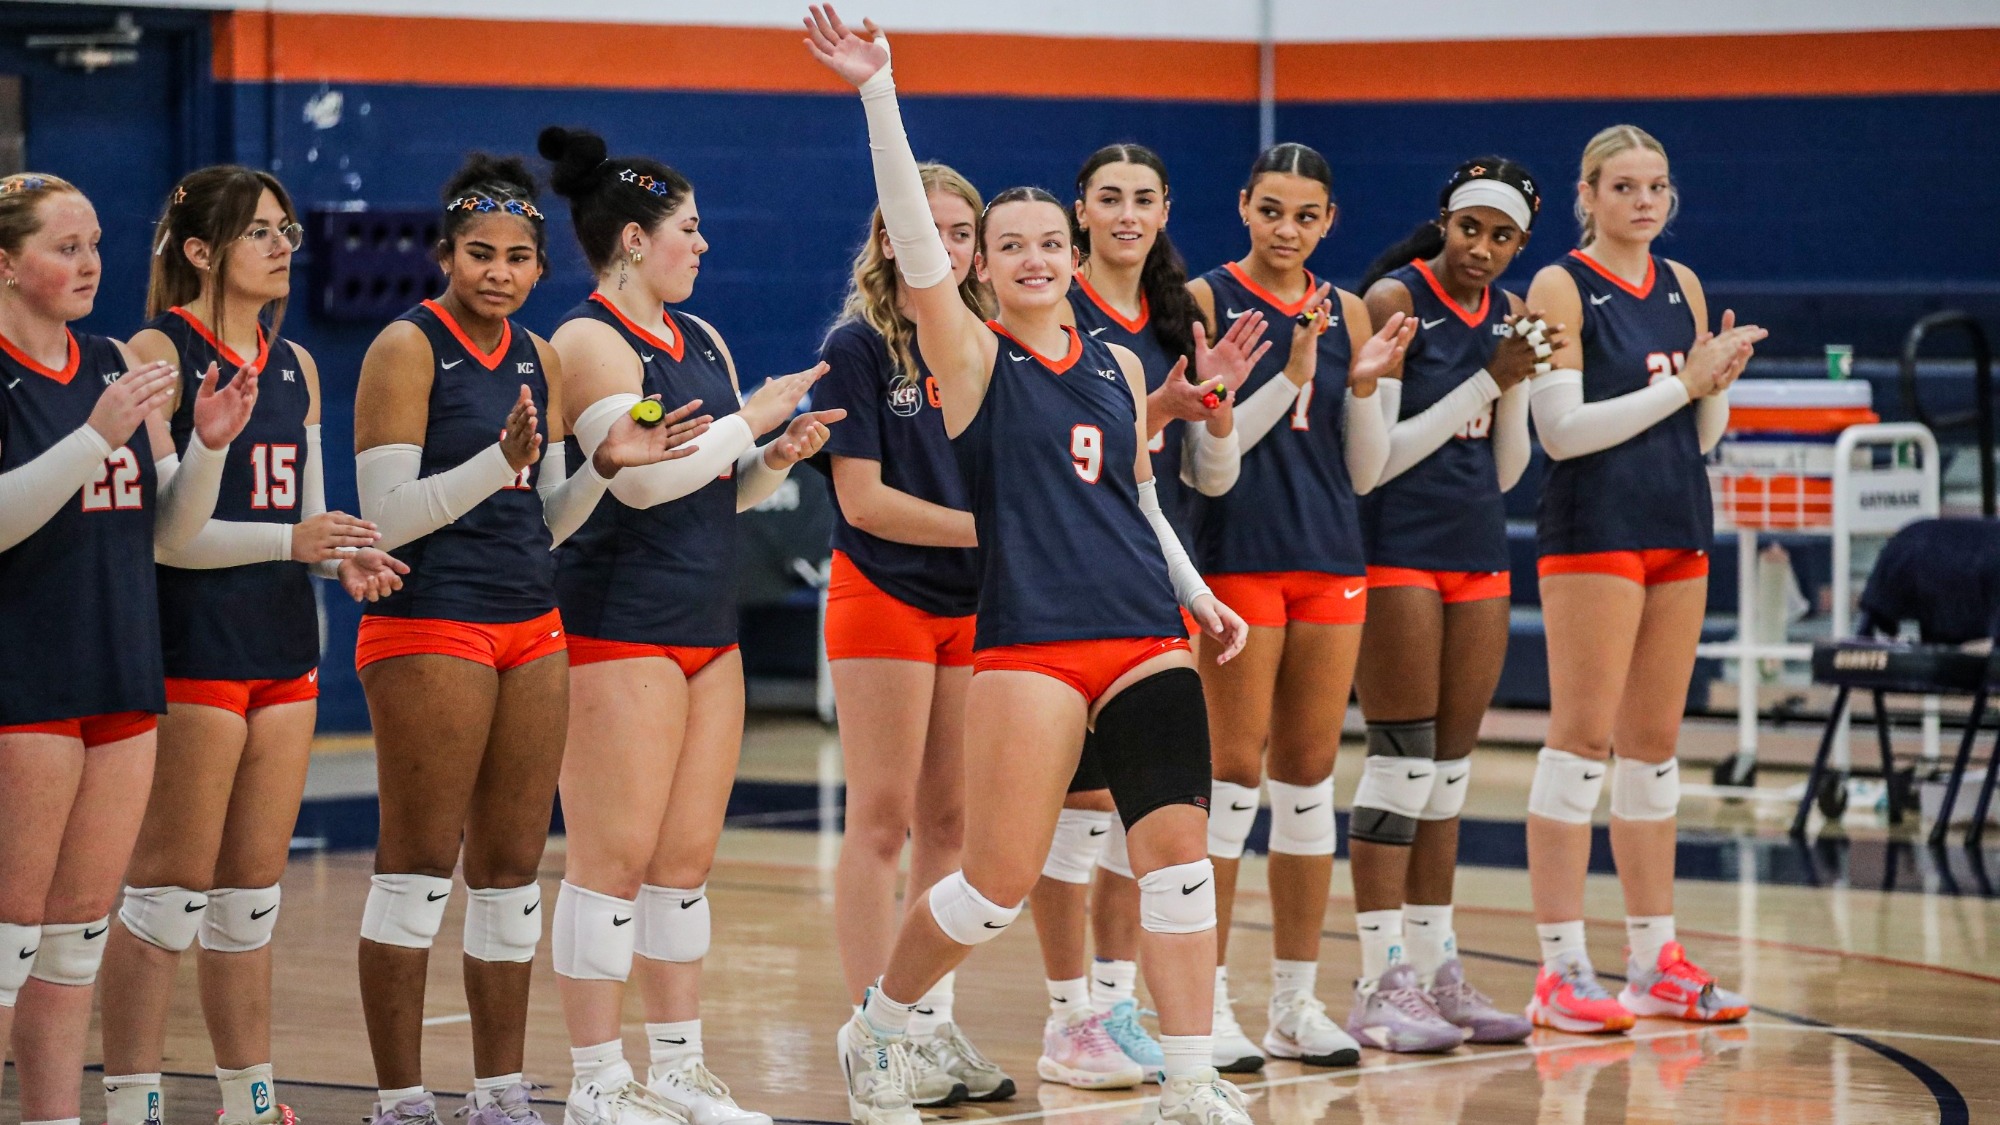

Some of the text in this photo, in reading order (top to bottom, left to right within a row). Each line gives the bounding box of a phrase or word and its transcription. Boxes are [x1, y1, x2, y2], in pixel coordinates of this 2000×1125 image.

[516, 362, 534, 374] KC
[1097, 369, 1116, 381] KC
[82, 445, 143, 512] 22
[251, 444, 298, 509] 15
[1070, 423, 1104, 485] 9
